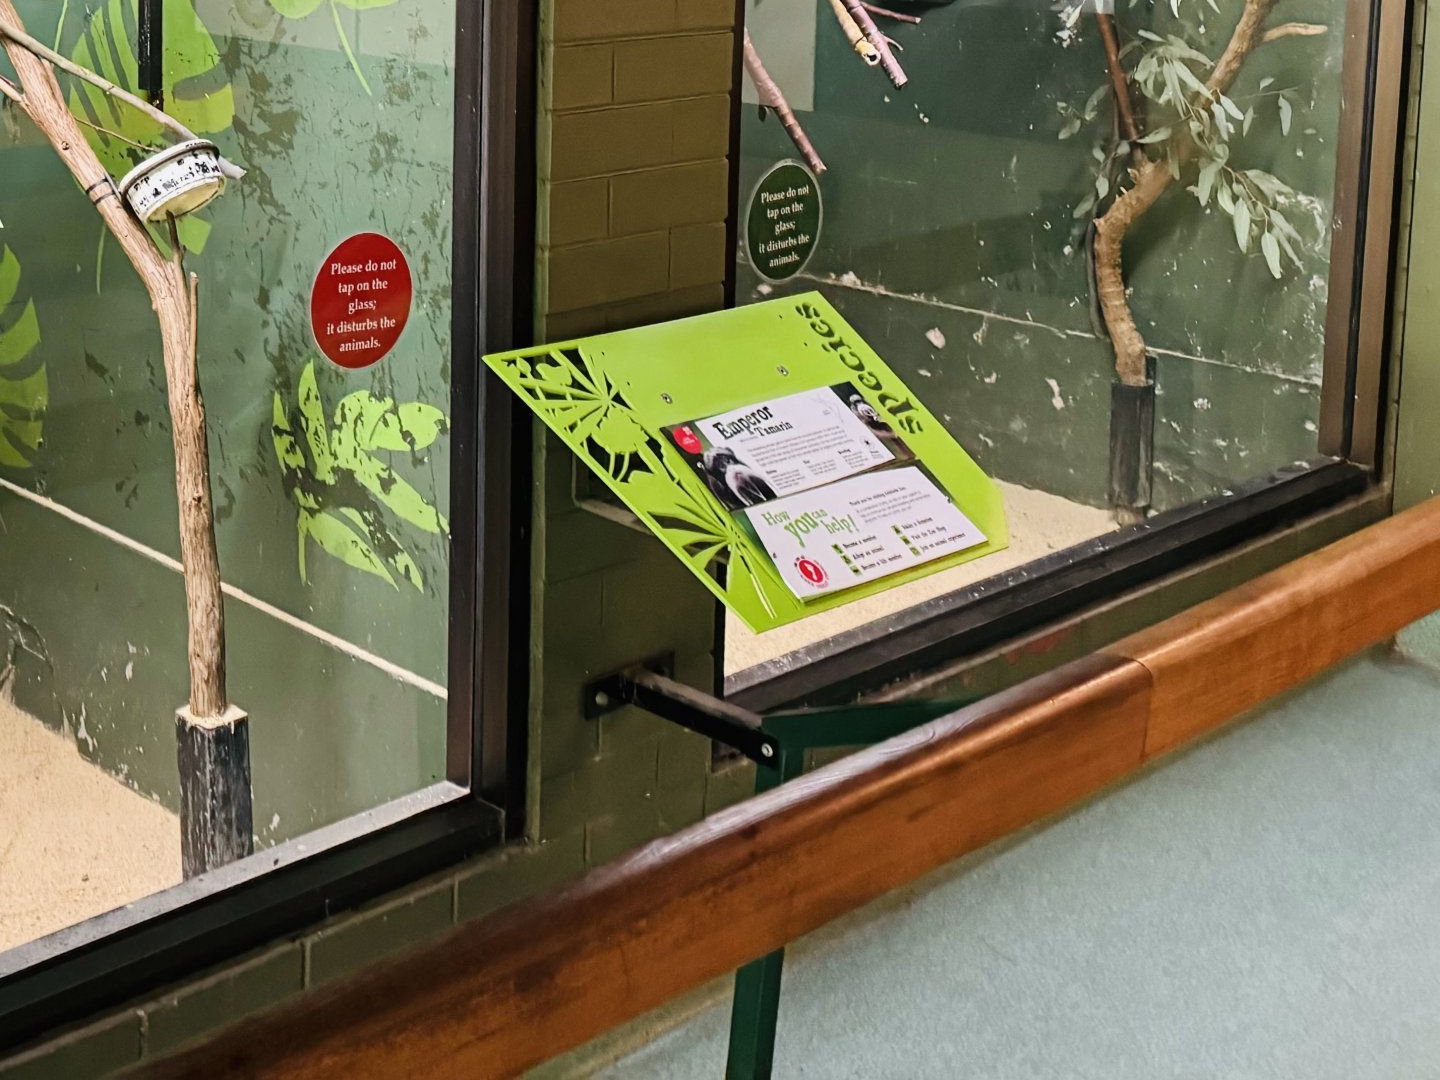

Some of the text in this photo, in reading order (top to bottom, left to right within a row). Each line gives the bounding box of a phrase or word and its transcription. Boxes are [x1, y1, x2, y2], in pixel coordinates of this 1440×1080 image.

[761, 184, 809, 203] Please do not
[767, 202, 804, 219] tap on the
[774, 220, 796, 235] glass;
[758, 234, 810, 254] it disturbs the
[331, 259, 397, 275] Please do not
[769, 251, 800, 267] animals.
[338, 278, 388, 296] tap on the
[348, 299, 377, 314] glass;
[326, 316, 396, 335] it disturbs the
[339, 336, 381, 352] animals.
[712, 406, 773, 440] Emperor
[754, 421, 794, 437] Tamarin
[761, 511, 791, 526] How
[820, 514, 860, 534] help!
[783, 512, 819, 548] you
